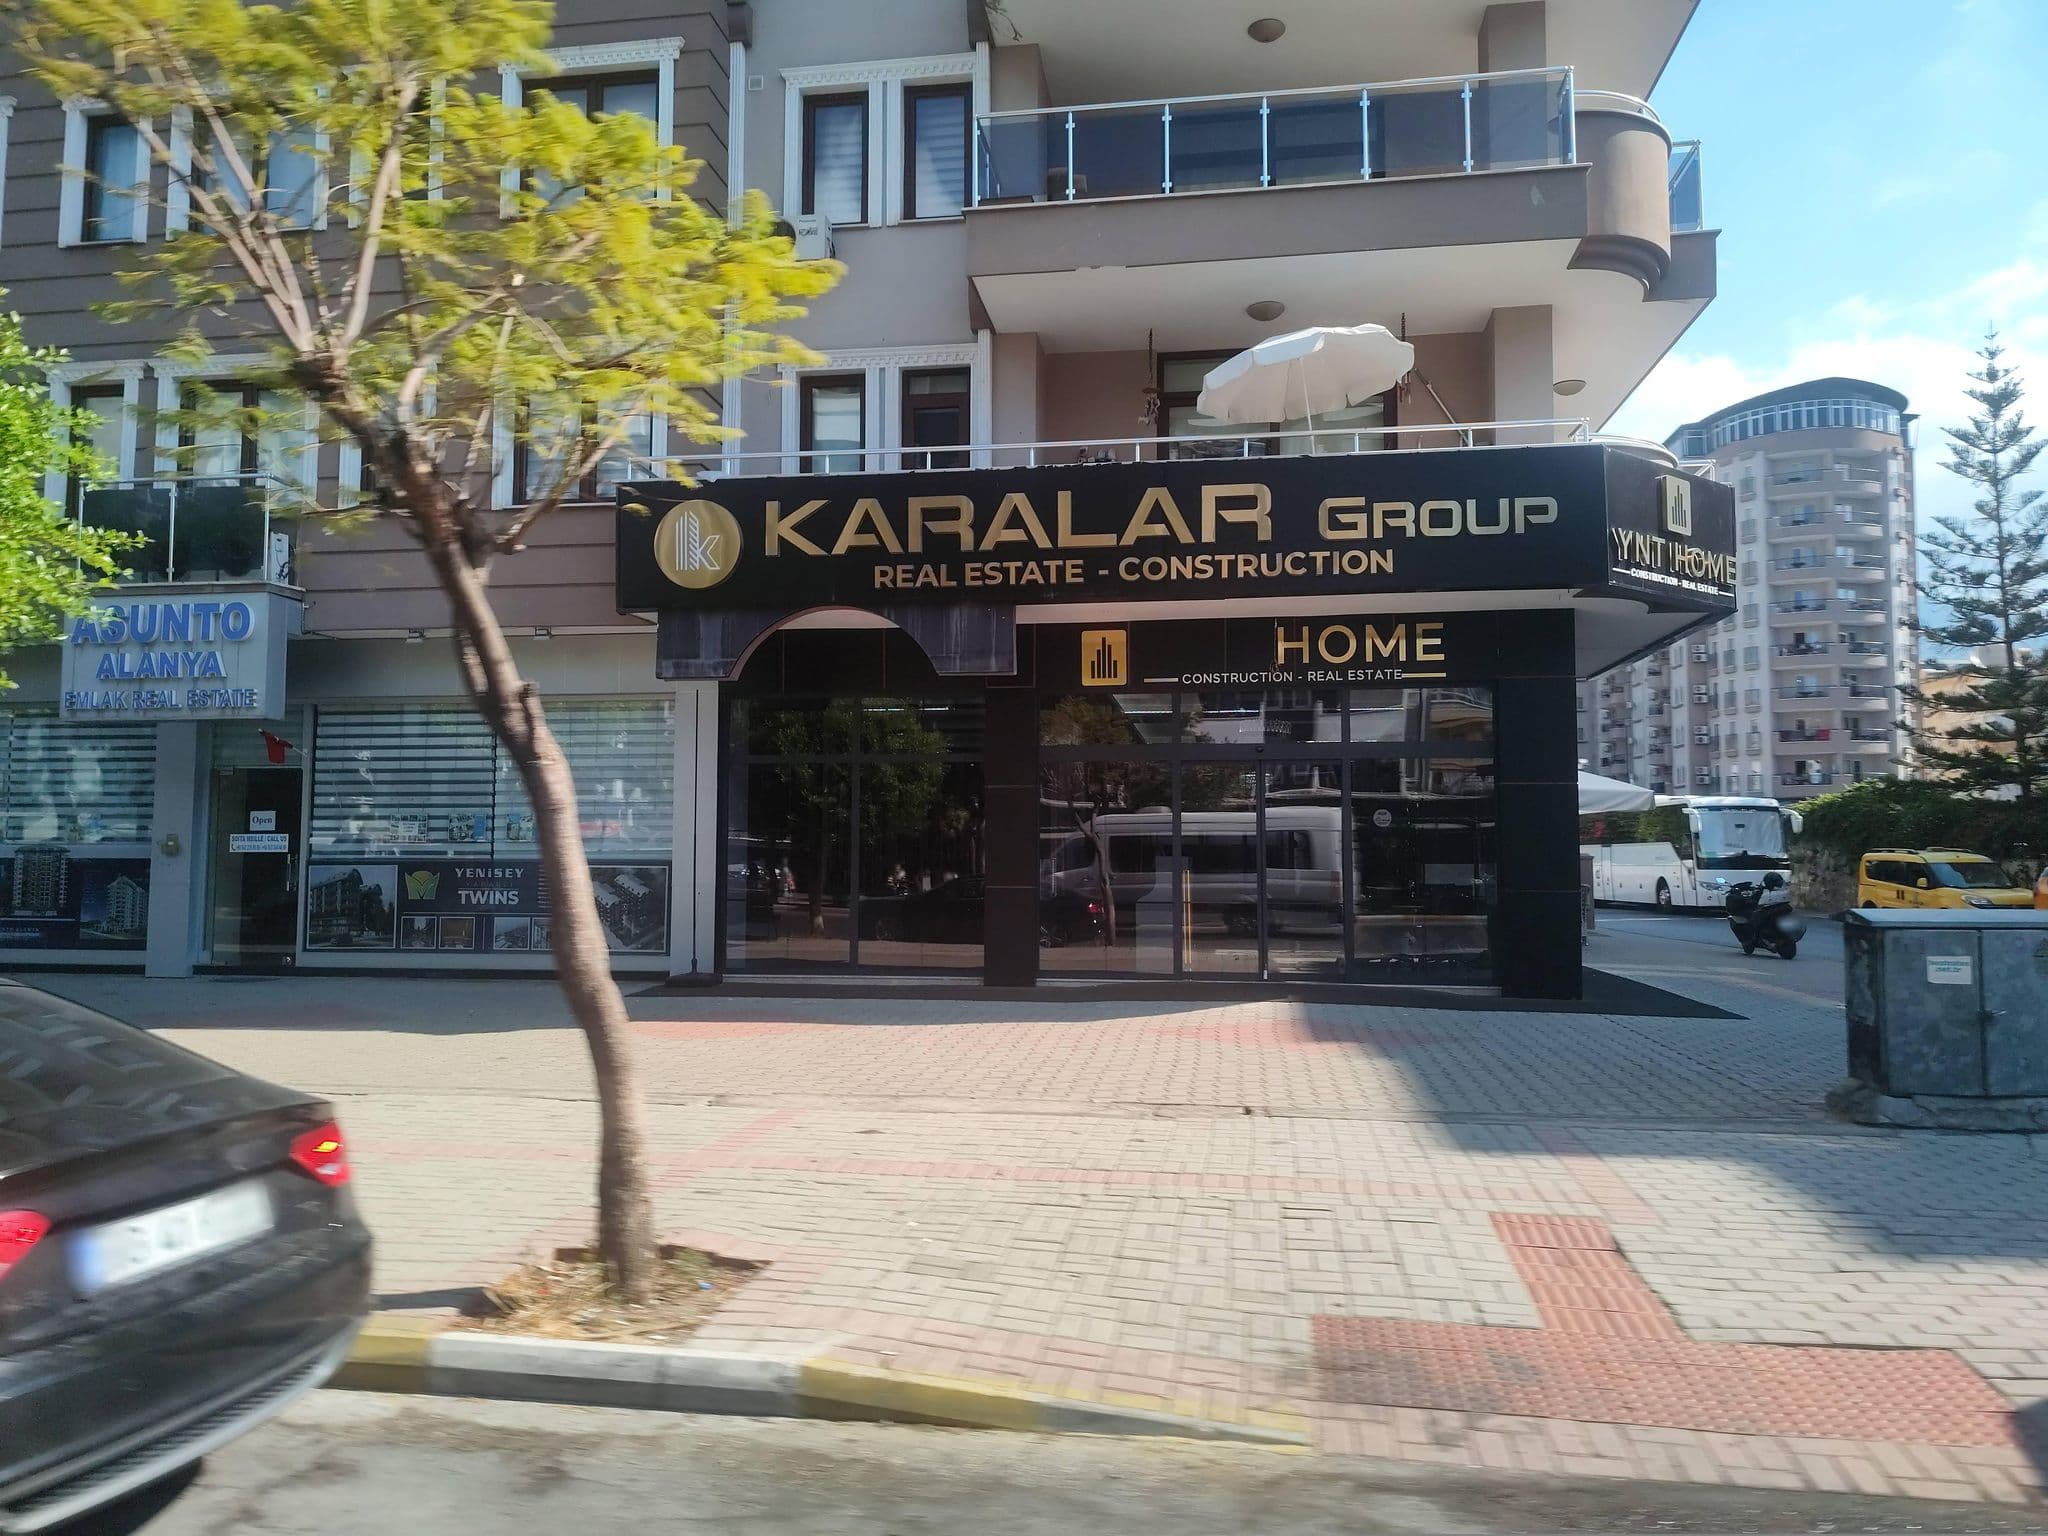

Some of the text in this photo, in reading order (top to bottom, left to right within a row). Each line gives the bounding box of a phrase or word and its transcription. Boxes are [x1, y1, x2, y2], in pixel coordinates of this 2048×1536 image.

[765, 484, 1559, 556] KARALAR GROUP
[874, 563, 956, 588] REAL
[965, 560, 1083, 585] ESTATE
[1119, 549, 1394, 582] CONSTRUCTION
[1612, 527, 1737, 586] YNT HOME
[1631, 567, 1678, 586] CONSTRUCTION
[1682, 578, 1697, 590] REAL
[1697, 583, 1719, 596] ESTATE
[72, 602, 254, 645] ASUNTO
[1277, 623, 1446, 664] HOME
[97, 651, 227, 678] ALANYA
[1182, 672, 1293, 685] CONSTRUCTION
[1307, 670, 1343, 682] REAL
[1348, 669, 1402, 681] ESTATE
[64, 688, 257, 711] EMLAK REAL ESTATE
[252, 815, 273, 824] Open
[458, 890, 519, 905] TWINS
